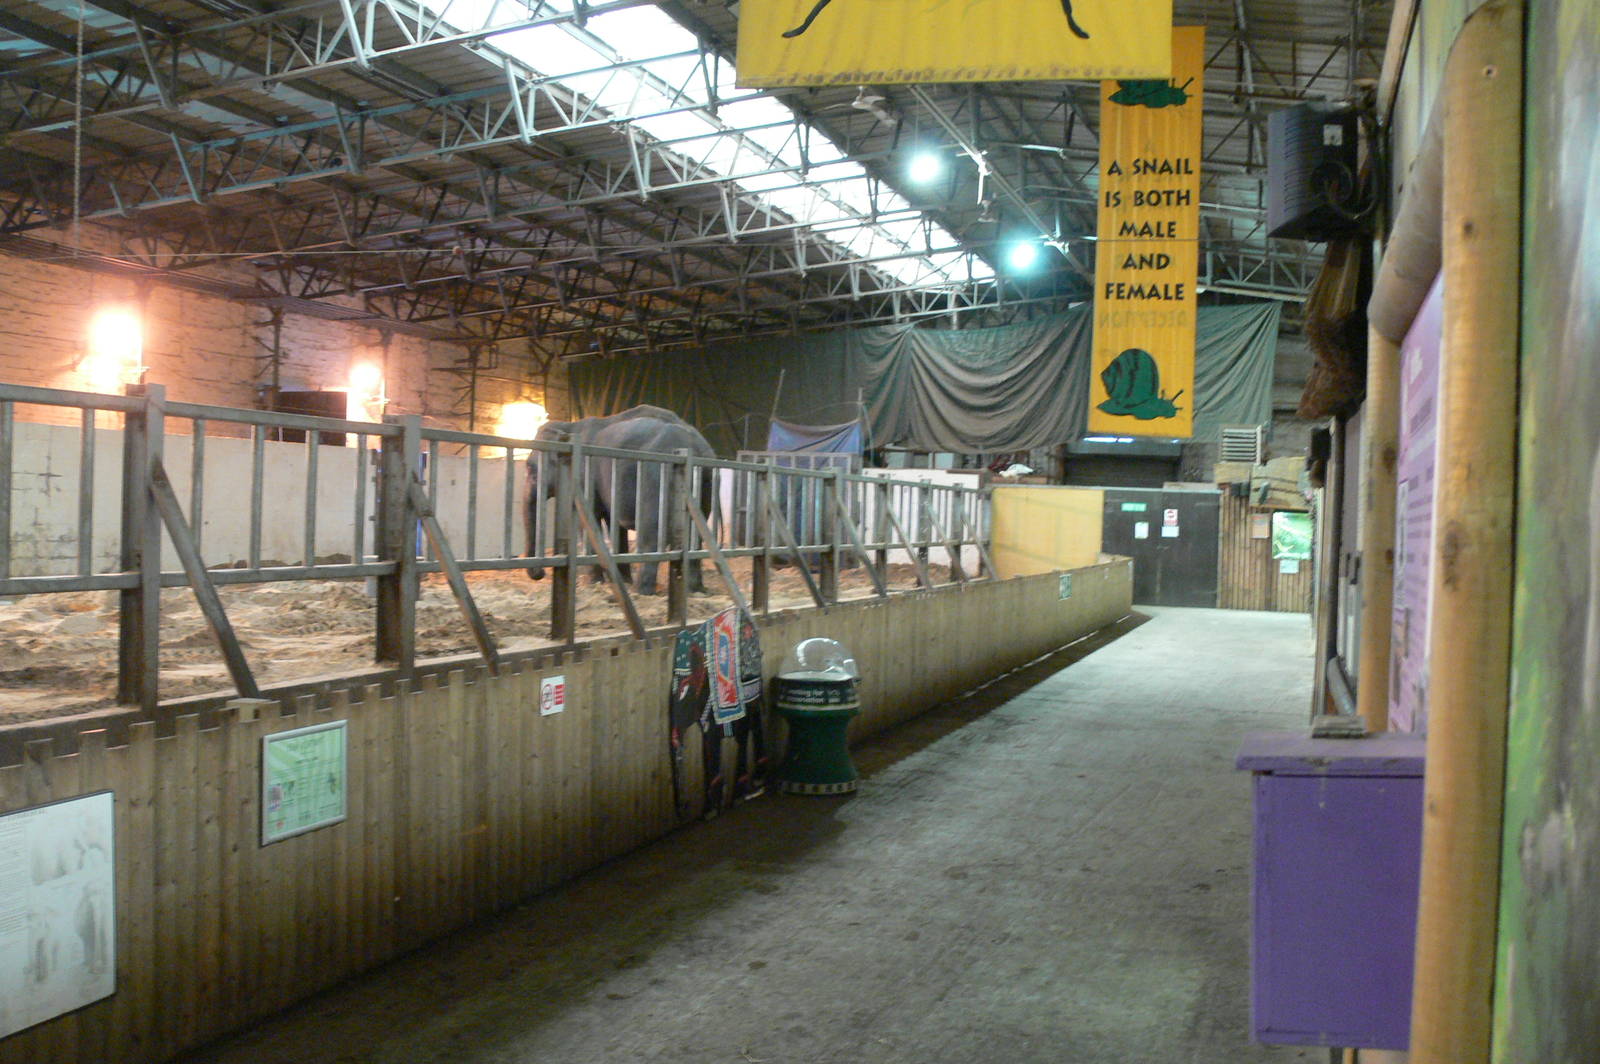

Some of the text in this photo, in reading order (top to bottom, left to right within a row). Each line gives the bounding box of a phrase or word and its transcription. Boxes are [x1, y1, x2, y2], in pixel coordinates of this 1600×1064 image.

[1108, 158, 1193, 175] A SNAIL
[1105, 189, 1191, 208] IS BOTH
[1118, 221, 1177, 238] MALE
[1122, 253, 1170, 270] AND
[1105, 282, 1185, 300] FEMALE
